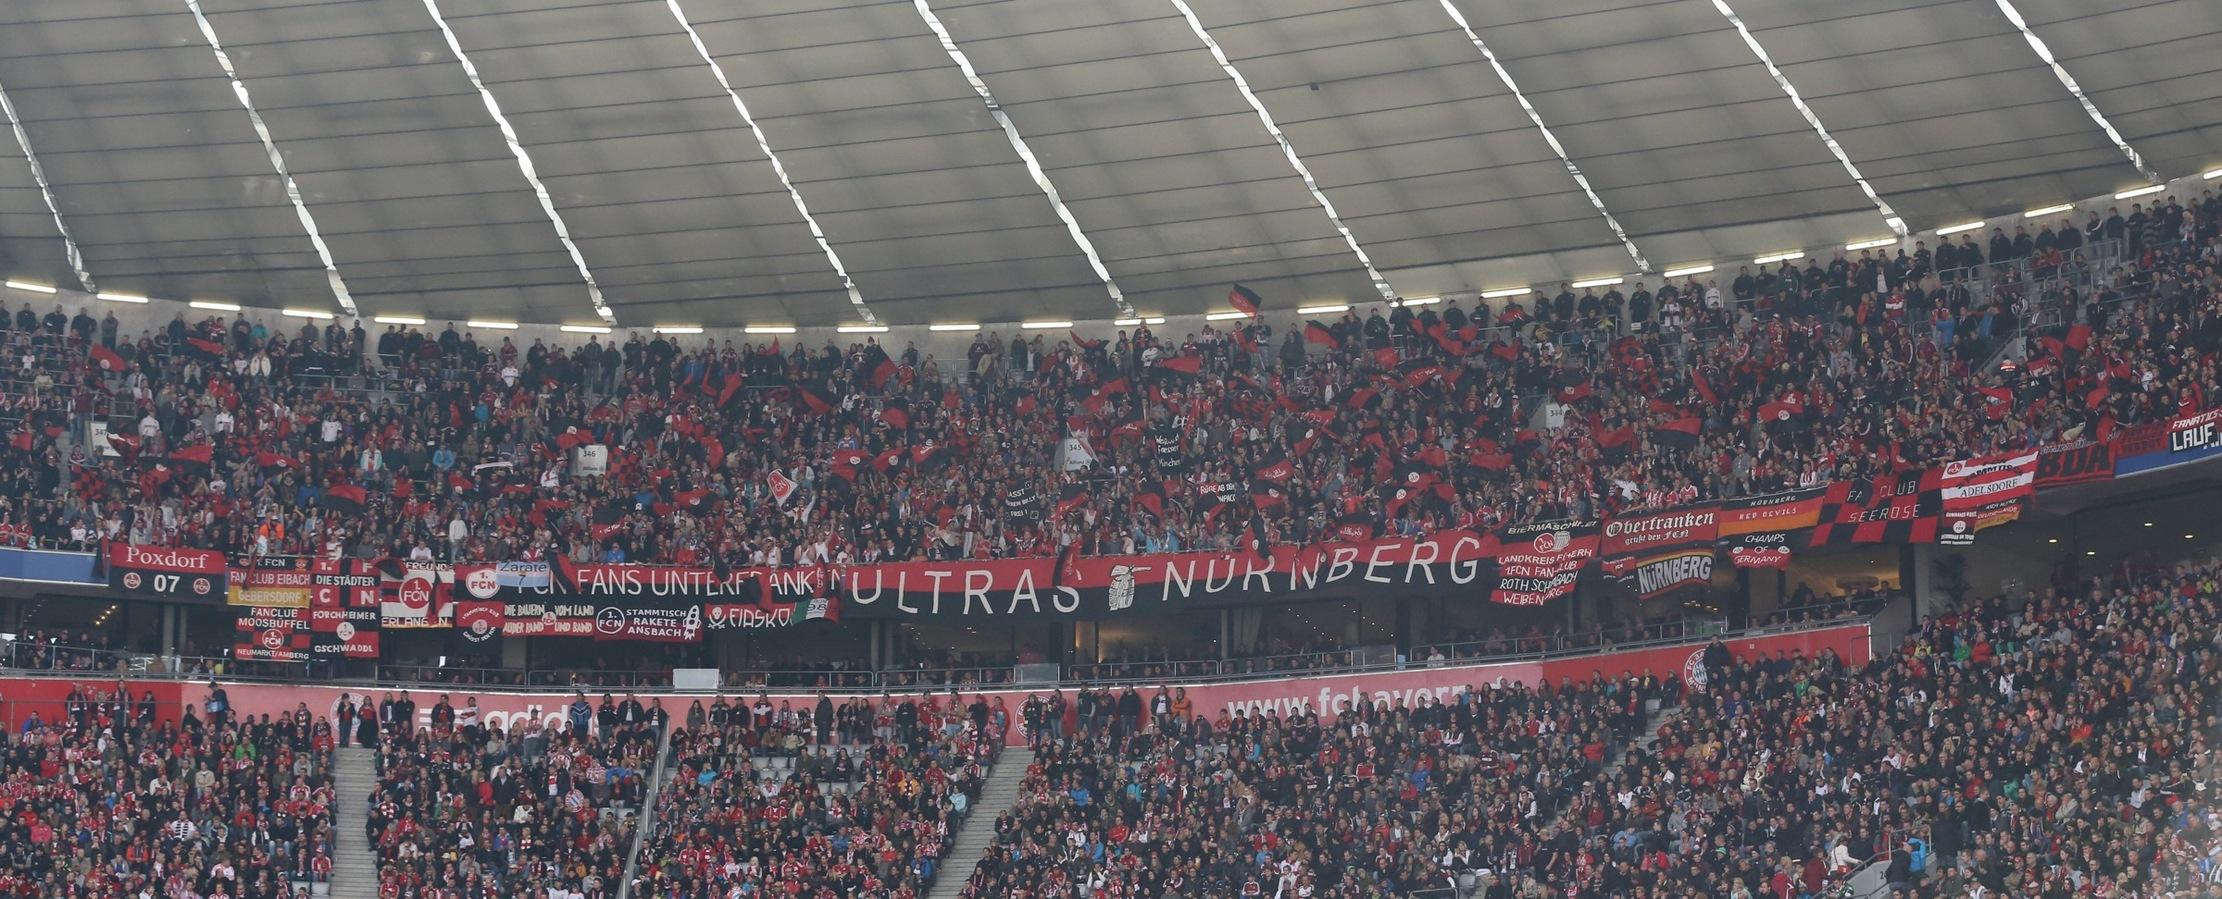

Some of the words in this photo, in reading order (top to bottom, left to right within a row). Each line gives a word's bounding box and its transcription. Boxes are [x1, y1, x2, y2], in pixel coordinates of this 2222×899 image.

[2172, 409, 2220, 429] FANATICS
[1846, 490, 1863, 502] FA
[1880, 479, 1916, 498] CLUB
[1960, 479, 2018, 497] ADELSDORF
[1739, 511, 1760, 520] RED
[1762, 507, 1798, 518] DEVILS
[1848, 503, 1921, 523] SEEROSE
[1606, 512, 1714, 538] Oberfranken
[1745, 533, 1786, 543] CHAMPS
[1754, 545, 1768, 554] OF
[127, 546, 209, 569] Poxdorf
[265, 558, 286, 566] FCN
[1498, 554, 1555, 565] LANDKREIS
[1734, 555, 1781, 564] GERMANY
[500, 560, 548, 574] Zarate
[1162, 536, 1481, 601] NÜRNBERG
[277, 573, 311, 585] EIBACH
[315, 575, 331, 586] DIE
[333, 574, 375, 587] STÄDTER
[518, 574, 527, 586] 7
[1637, 556, 1712, 595] NÜRNBERG
[153, 574, 181, 592] 07
[471, 580, 496, 590] FCN
[577, 569, 643, 596] FANS
[1500, 578, 1529, 591] ROTH
[403, 590, 430, 602] FCN
[853, 569, 1081, 615] ULTRAS
[250, 607, 299, 618] FANCLUB
[312, 610, 377, 621] FORCHHEIMER
[504, 604, 517, 617] DIE
[517, 603, 545, 616] BAUERN
[554, 604, 573, 617] VOM
[573, 604, 595, 617] LAND
[626, 608, 687, 618] STAMMTISCH
[238, 617, 311, 631] MOOSBÜFFEL
[554, 621, 571, 633] UND
[599, 619, 623, 628] FCN
[633, 617, 677, 628] RAKETE
[627, 626, 682, 637] ANSBACH
[263, 637, 283, 646] FCN
[237, 648, 310, 661] NEUMARKT/AMBERG
